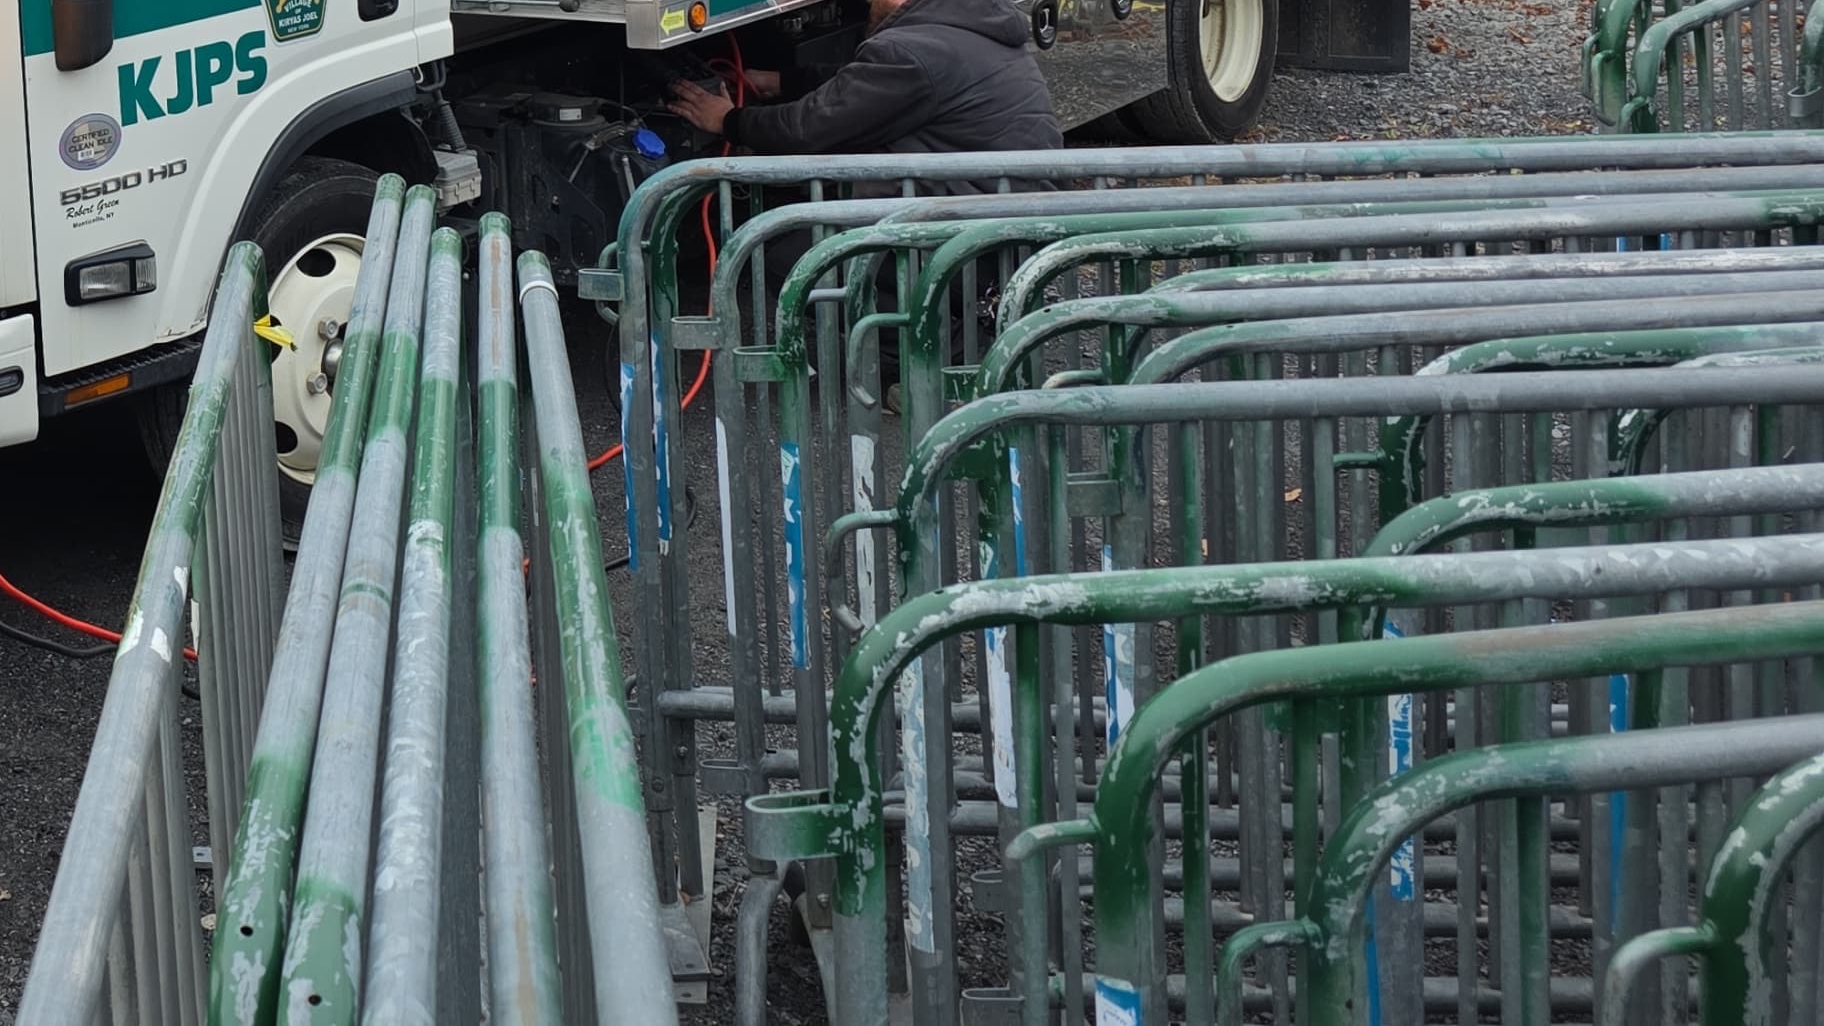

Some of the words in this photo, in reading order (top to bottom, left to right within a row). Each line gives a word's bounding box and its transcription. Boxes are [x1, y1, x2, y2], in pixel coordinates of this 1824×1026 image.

[278, 15, 302, 28] KIRYAS
[302, 11, 318, 23] JOEL
[118, 31, 268, 127] KJPS
[68, 140, 95, 154] CLEAN
[96, 136, 113, 147] IDLE
[71, 128, 110, 144] CERTIFIED
[60, 172, 142, 206] 5500
[148, 159, 188, 184] HD
[66, 204, 94, 220] Robert
[96, 199, 119, 215] Green
[106, 212, 115, 220] NY
